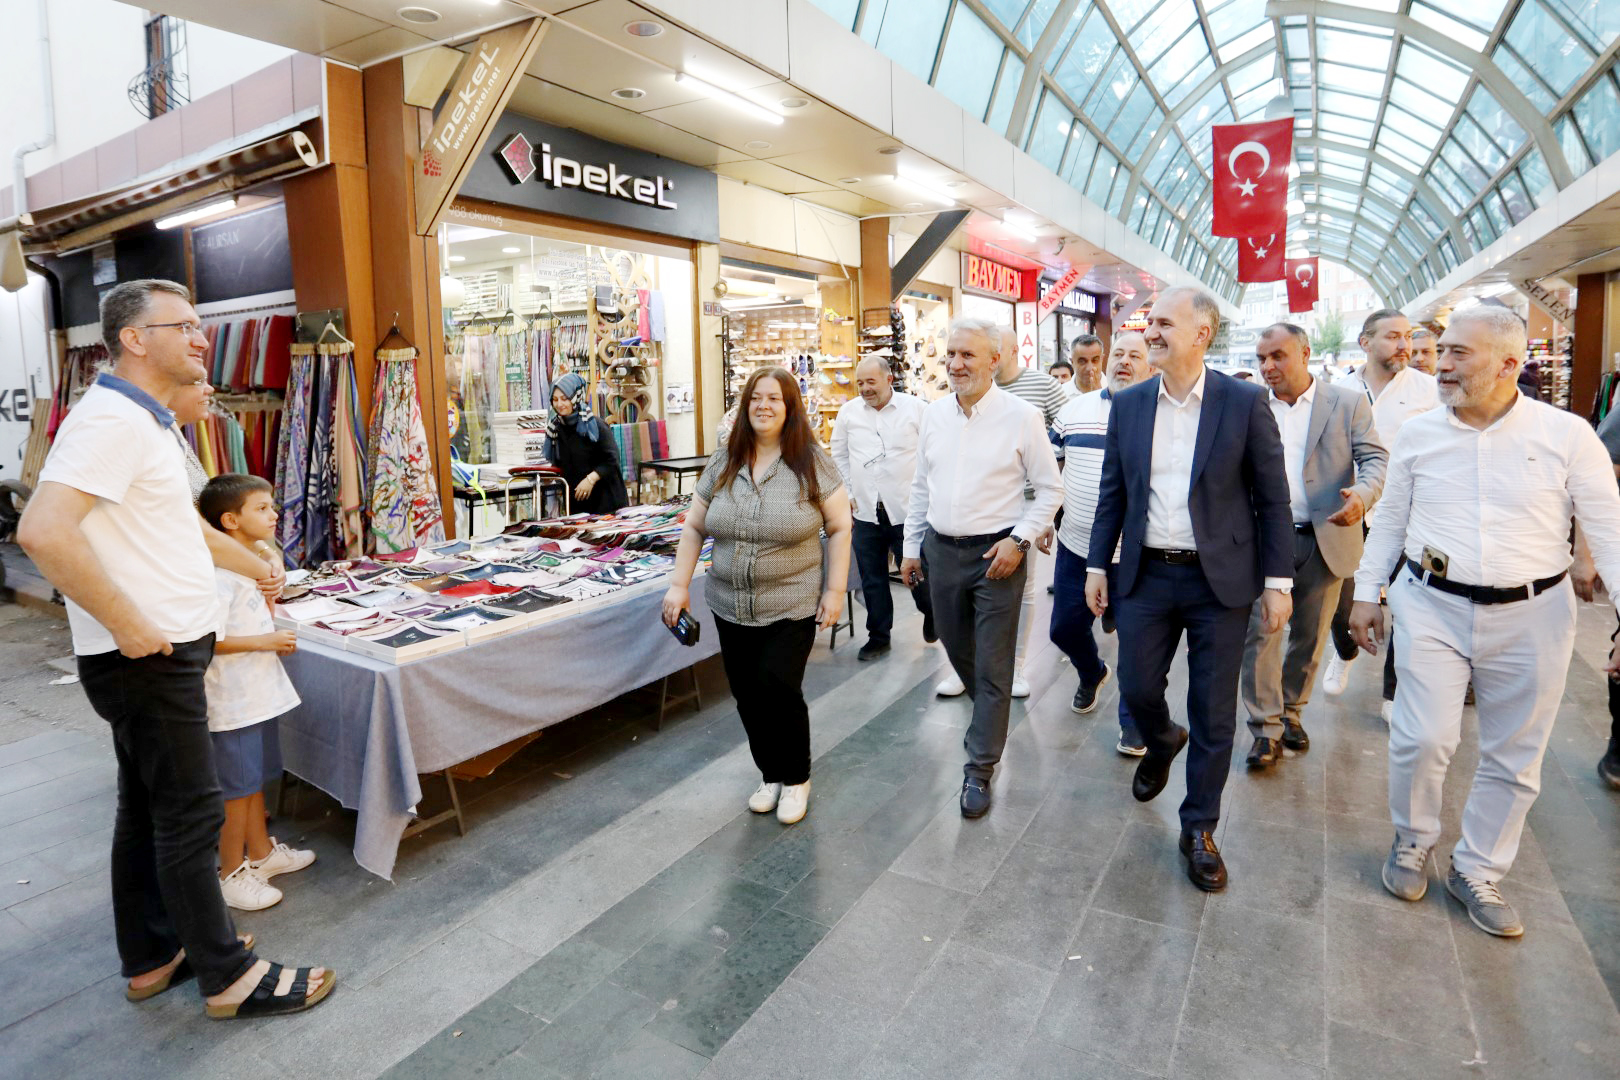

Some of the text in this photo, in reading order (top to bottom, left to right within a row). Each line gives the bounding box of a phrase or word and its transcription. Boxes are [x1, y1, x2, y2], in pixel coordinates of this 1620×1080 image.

[967, 255, 1022, 299] BAYMEN
[1041, 269, 1079, 310] BAYMEN
[1520, 279, 1576, 320] SELEN
